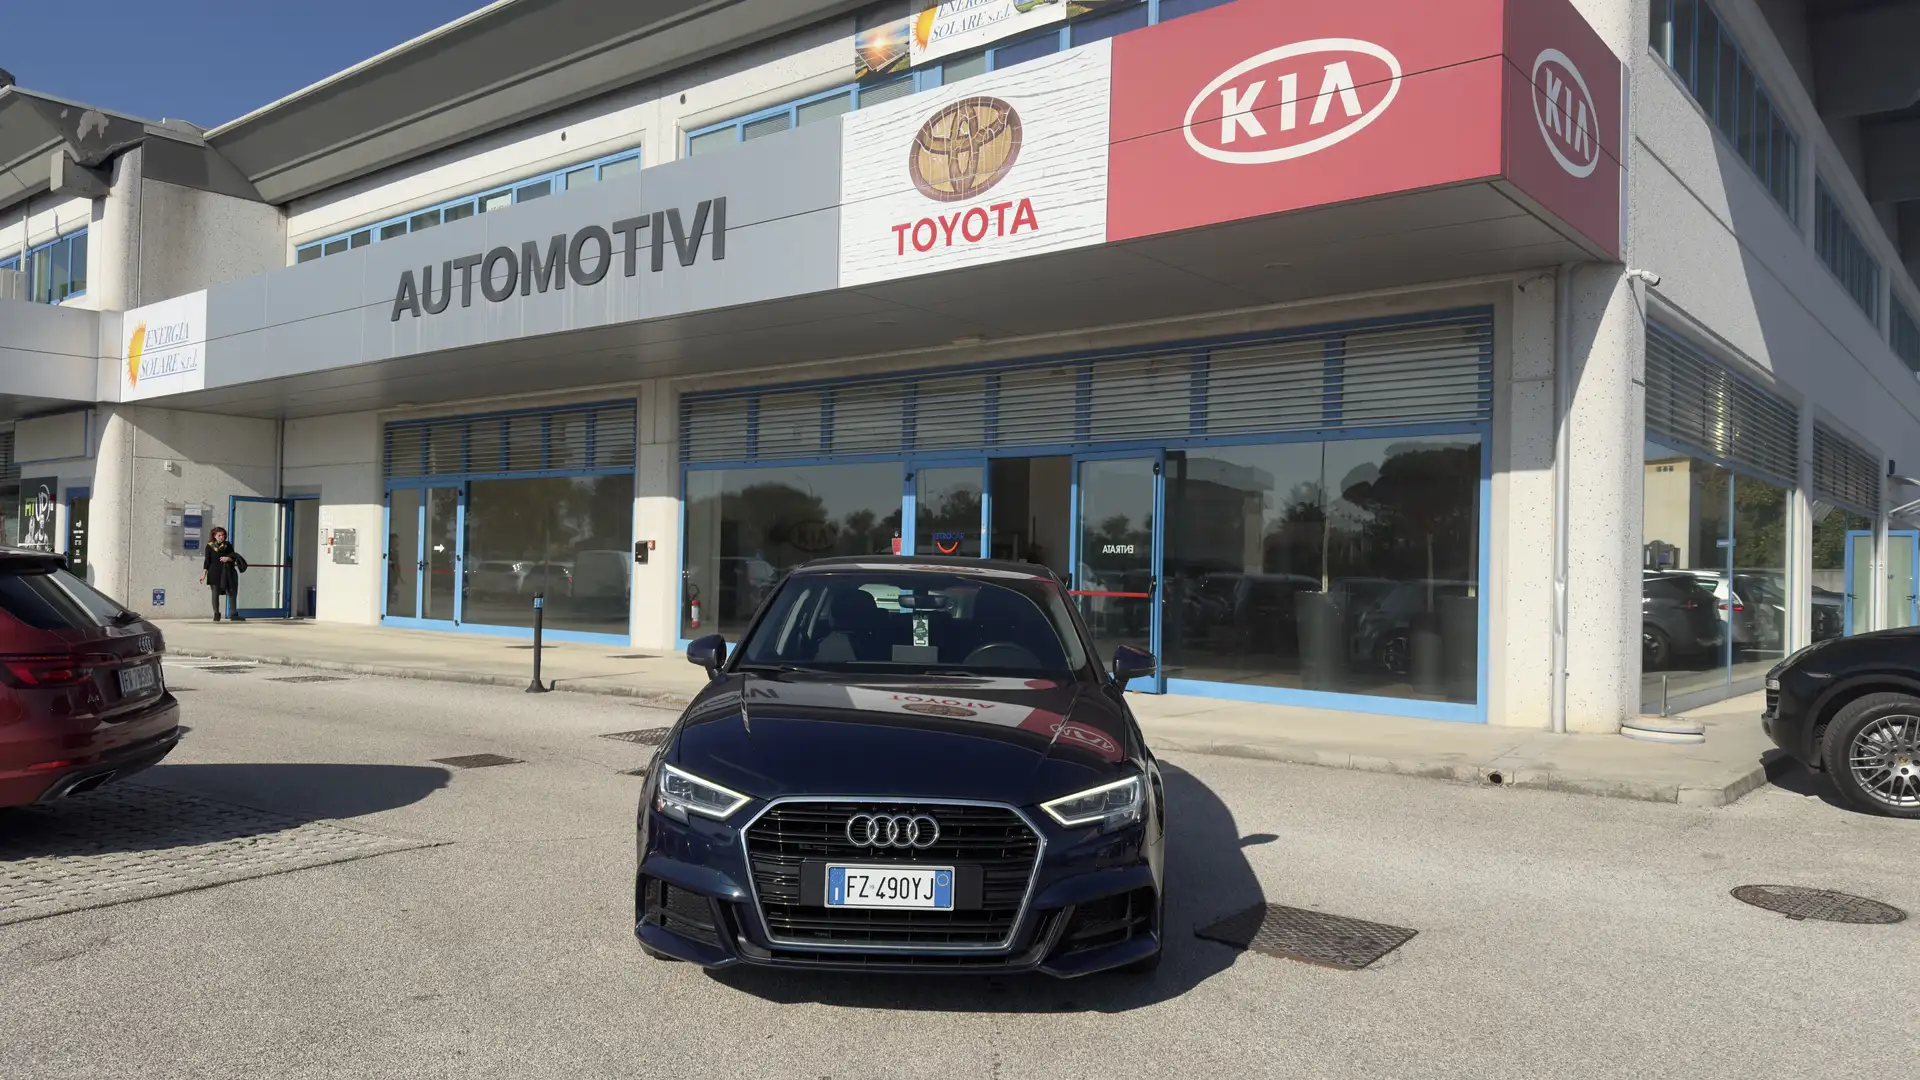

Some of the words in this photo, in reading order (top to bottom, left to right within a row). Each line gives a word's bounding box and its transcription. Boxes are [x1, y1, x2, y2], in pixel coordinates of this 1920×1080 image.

[932, 11, 986, 40] SOLARE
[1221, 60, 1363, 144] KIA
[1545, 67, 1590, 162] KIA
[891, 197, 1039, 256] TOYOTA
[390, 196, 727, 322] AUTOMOTIVI
[145, 322, 189, 348] ENERGIA
[140, 353, 181, 378] SOLARE
